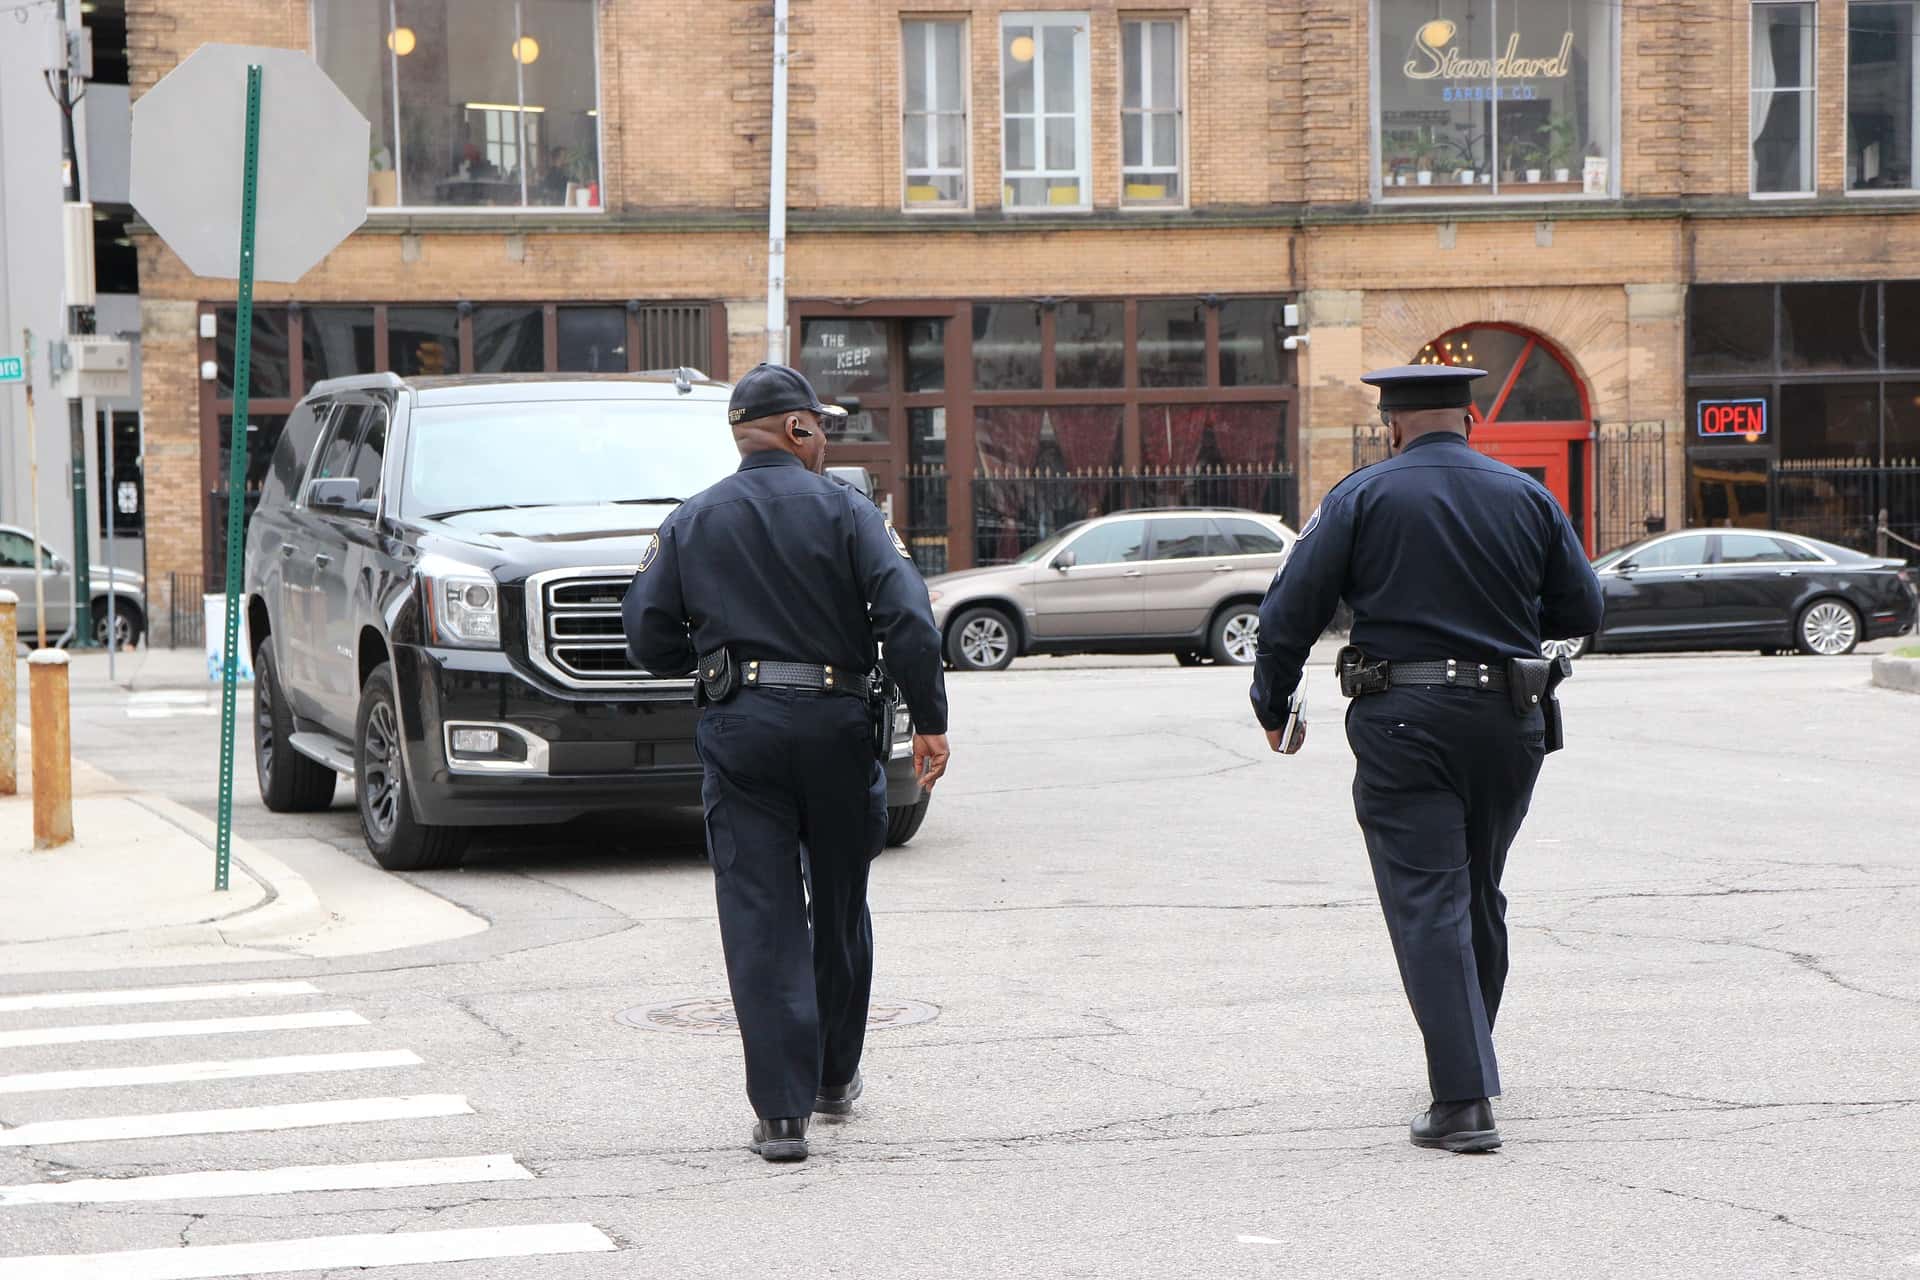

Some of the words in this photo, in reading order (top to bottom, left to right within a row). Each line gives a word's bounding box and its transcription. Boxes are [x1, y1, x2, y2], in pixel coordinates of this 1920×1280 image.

[1403, 20, 1574, 79] Standard
[821, 334, 845, 347] THE
[837, 347, 871, 369] KEEP
[1704, 406, 1762, 433] OPEN
